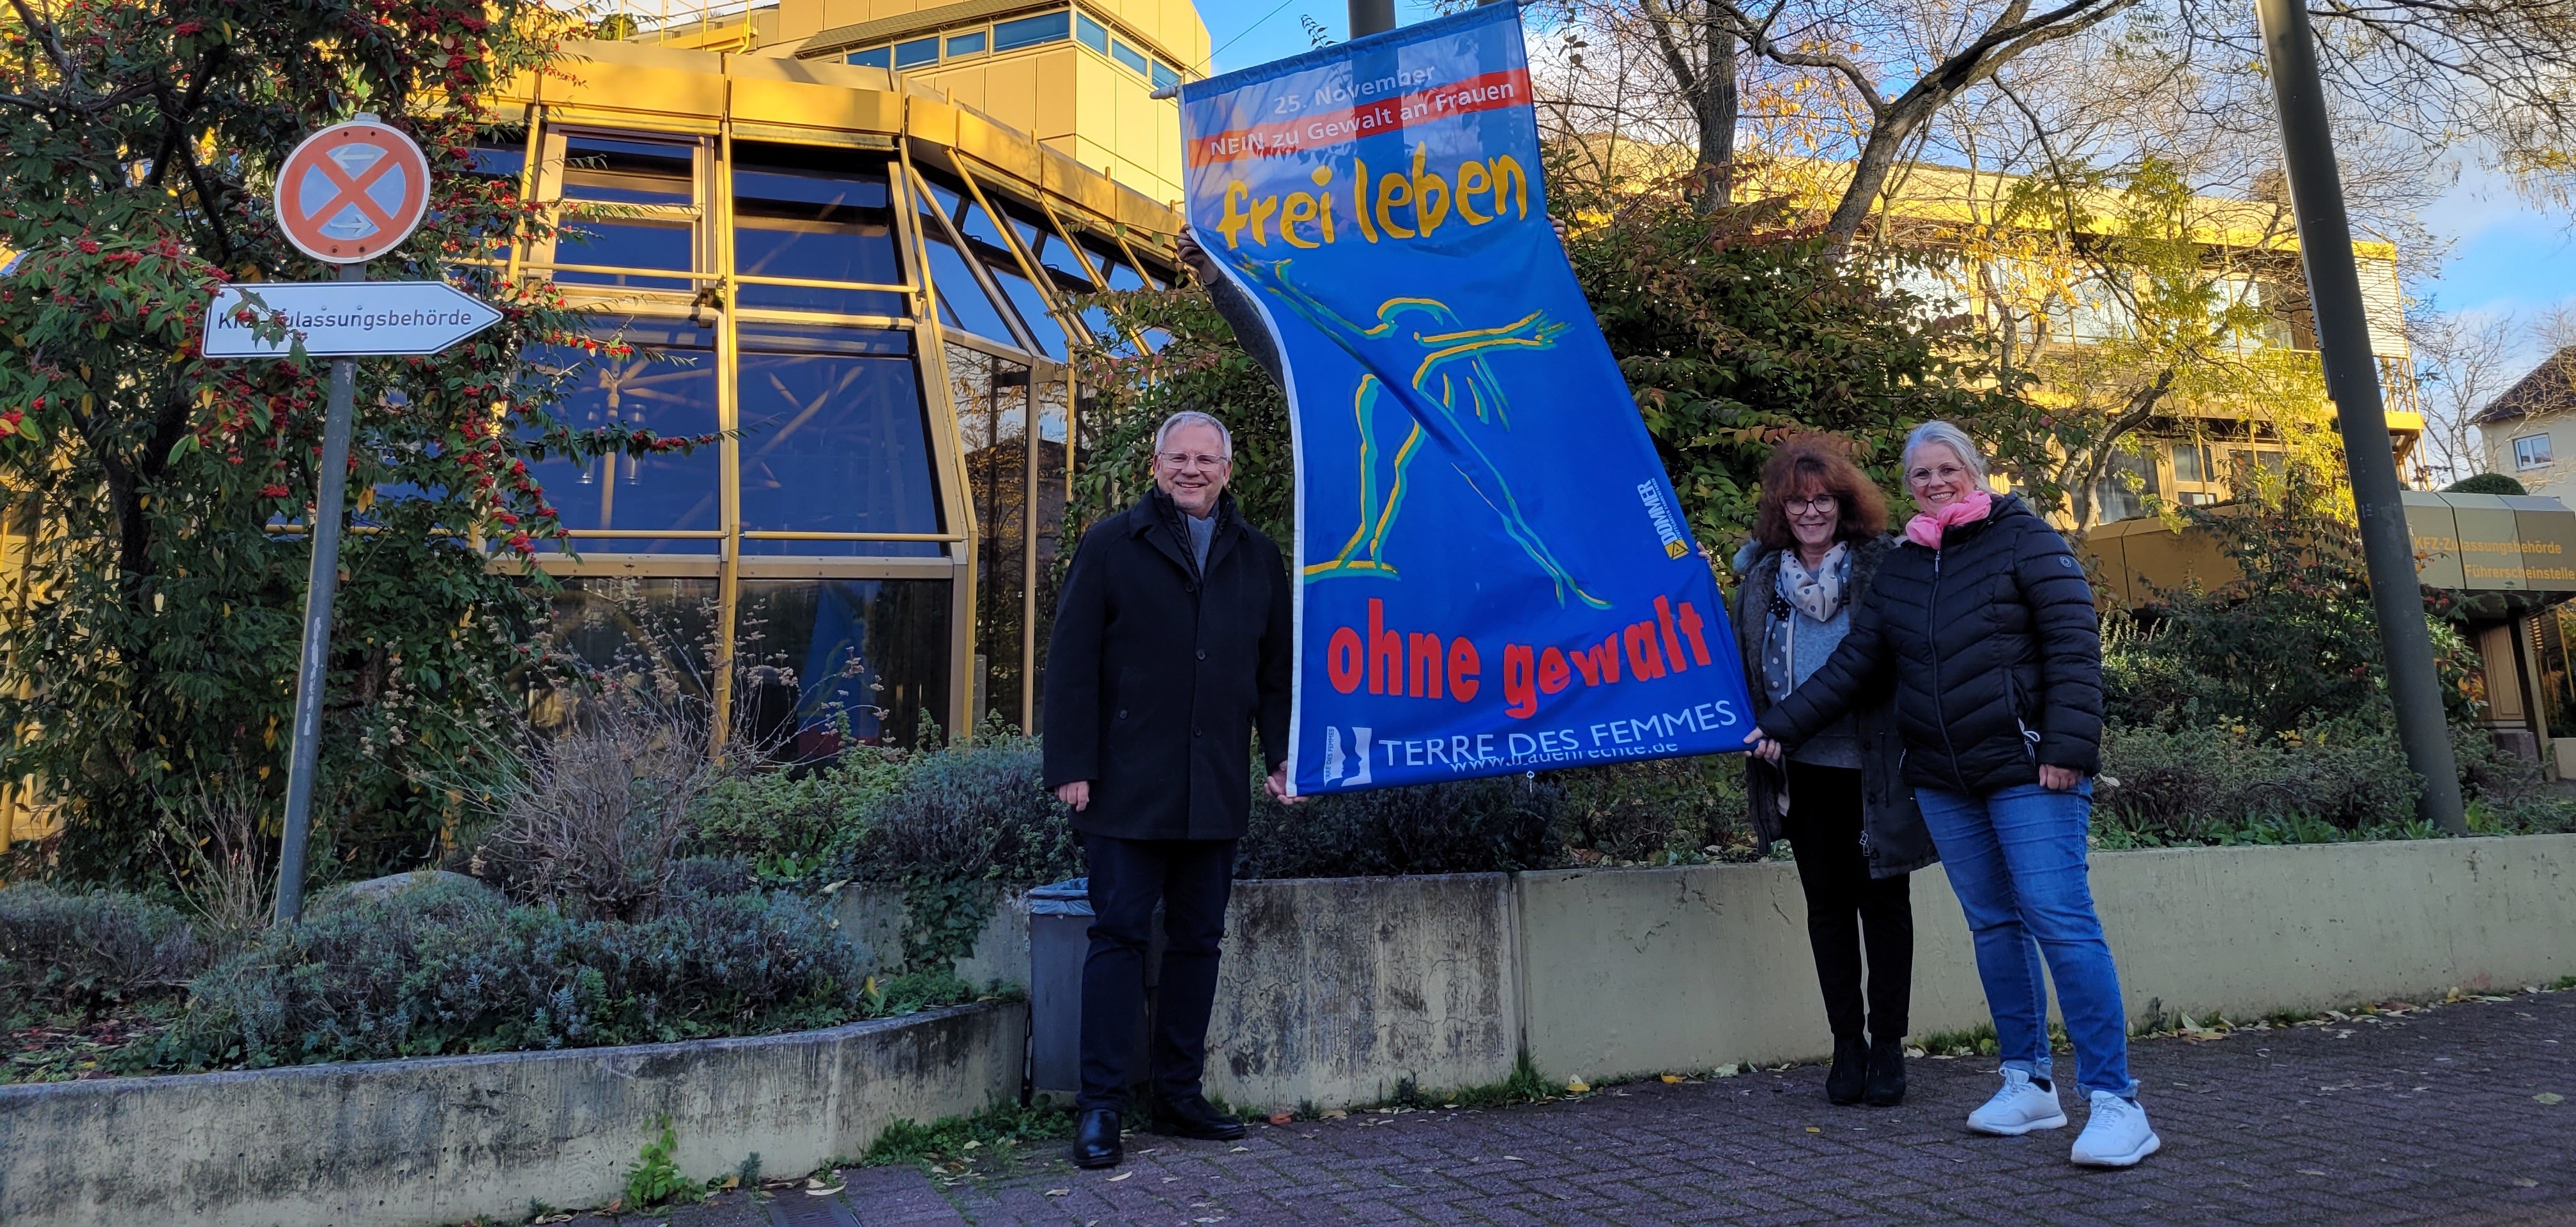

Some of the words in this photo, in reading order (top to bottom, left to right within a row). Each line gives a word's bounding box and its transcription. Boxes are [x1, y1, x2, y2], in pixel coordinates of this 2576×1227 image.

[1211, 133, 1264, 156] NEIN
[1273, 130, 1300, 148] zu
[1307, 107, 1393, 139] Gewalt
[1400, 102, 1428, 120] an
[1435, 81, 1514, 112] Frauen
[1273, 95, 1307, 114] 25.
[1314, 66, 1435, 106] November
[1216, 165, 1334, 249] frei
[1354, 141, 1528, 243] leben
[1637, 479, 1678, 546] DOMMER
[2414, 537, 2562, 555] KFZ-Zulassungsbehörde
[2464, 564, 2575, 580] Führerscheinstelle
[1327, 598, 1481, 703] ohne
[1503, 594, 1712, 719] gewalt
[1379, 733, 1496, 767] TERRE
[1509, 729, 1579, 756] DES
[1594, 700, 1737, 747] FEMMES
